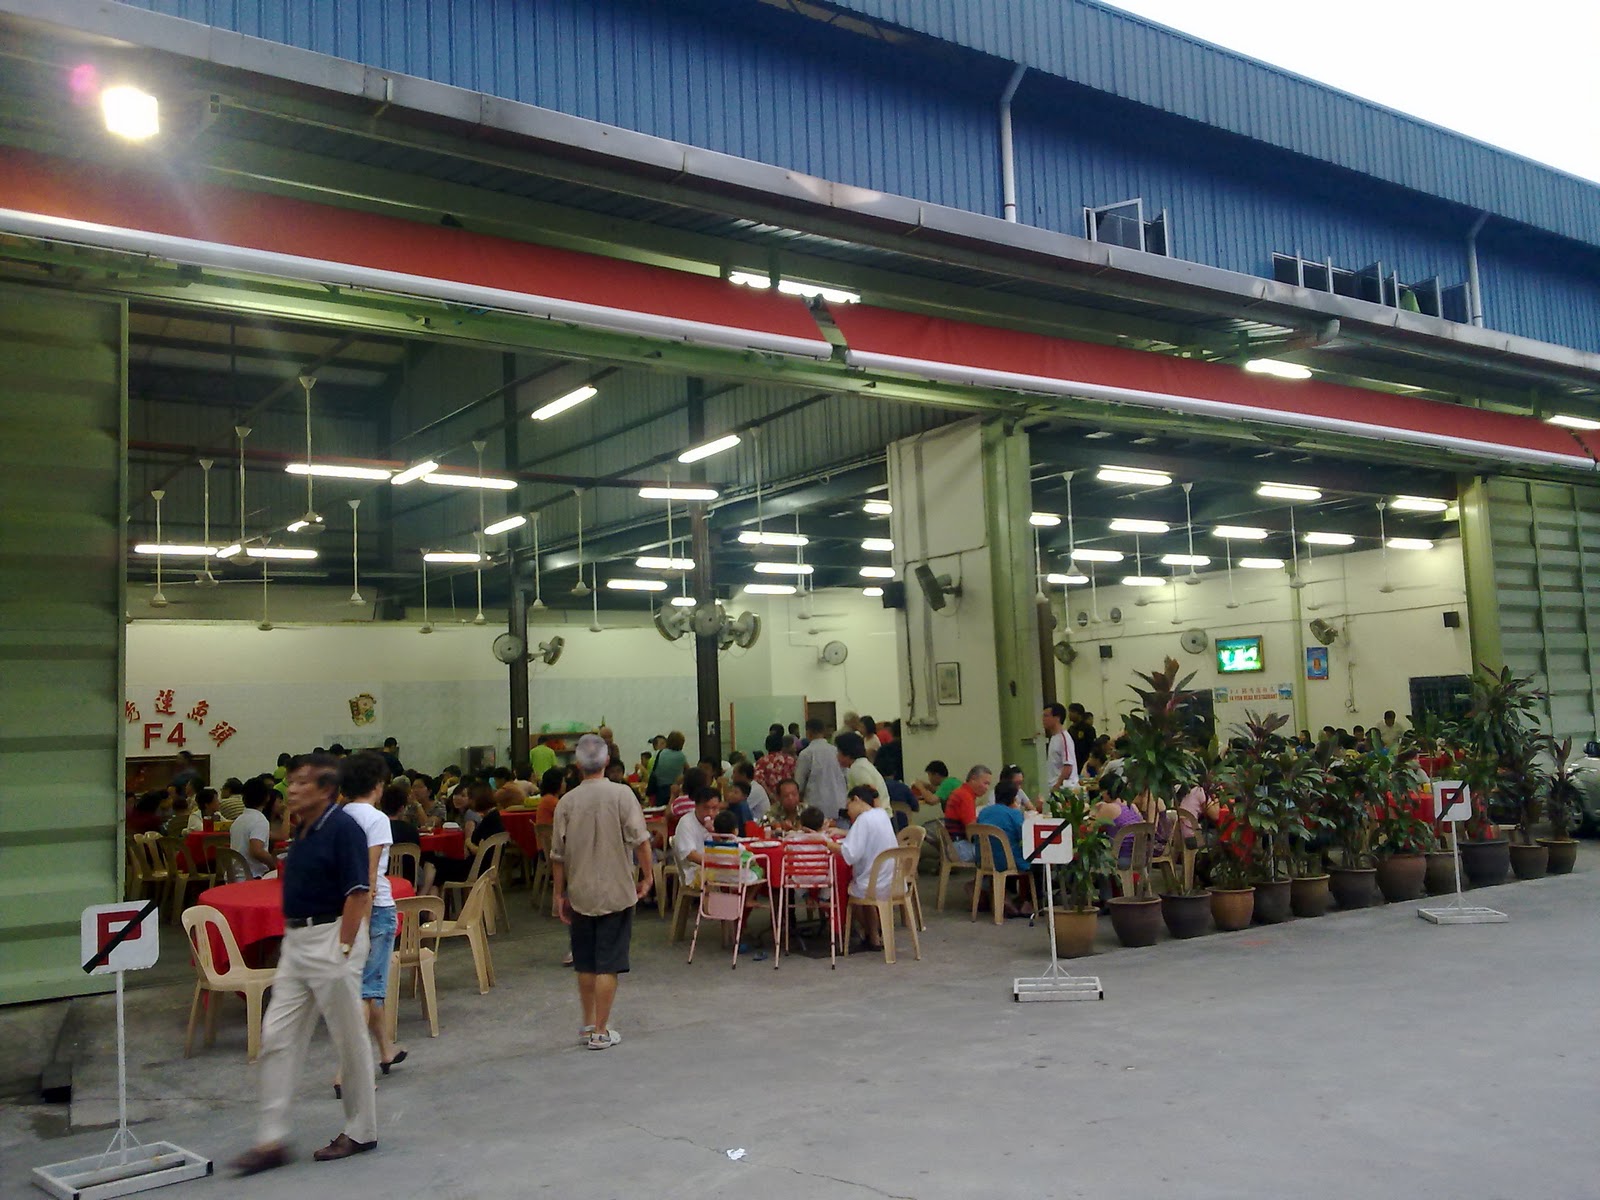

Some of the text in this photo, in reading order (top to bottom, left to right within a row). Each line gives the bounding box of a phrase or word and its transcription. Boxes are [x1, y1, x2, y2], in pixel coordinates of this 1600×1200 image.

[144, 722, 187, 749] F4
[1034, 824, 1062, 859] P
[96, 910, 142, 967] P
